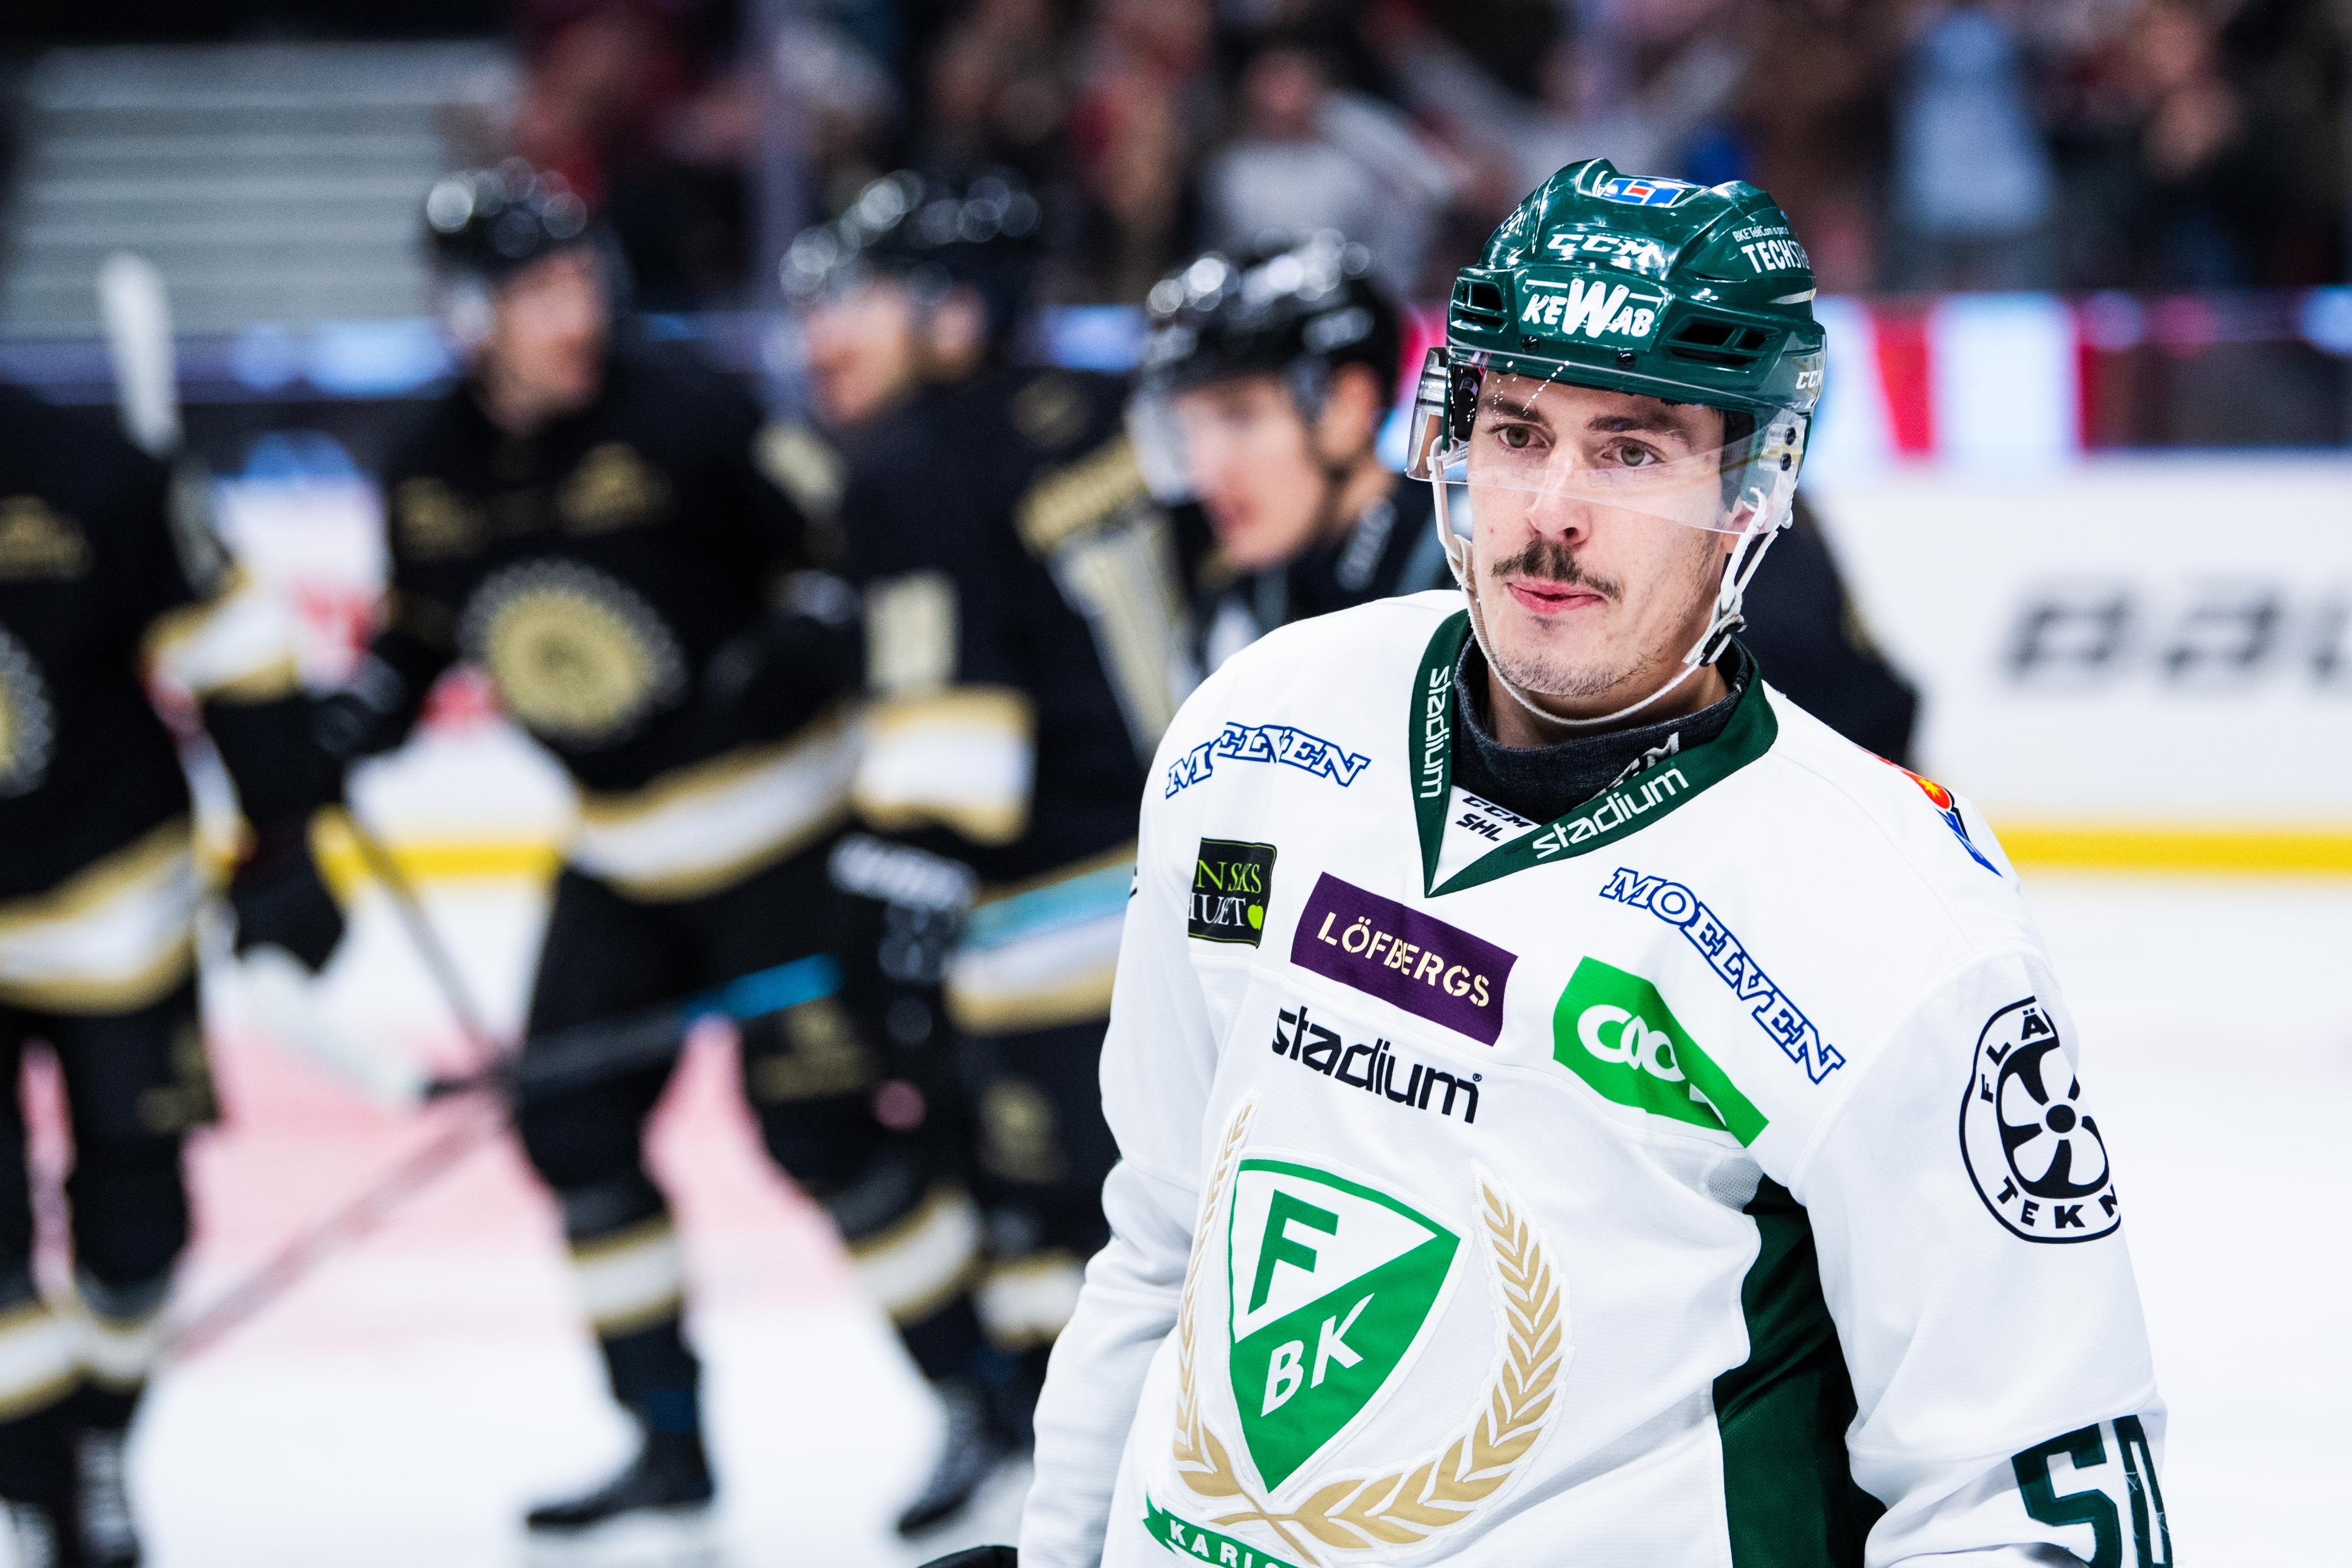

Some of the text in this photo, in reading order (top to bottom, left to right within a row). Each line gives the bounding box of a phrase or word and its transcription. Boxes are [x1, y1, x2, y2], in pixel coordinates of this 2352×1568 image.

[1547, 234, 1659, 262] CCM
[1419, 665, 1452, 799] stadium
[1455, 813, 1503, 842] SHL
[1462, 795, 1533, 828] CCM
[1532, 768, 1689, 859] stadium
[1317, 911, 1489, 1007] LÖFBERGS
[1599, 867, 1846, 1085] MOELVEN
[1247, 1189, 1339, 1316] F
[1260, 1292, 1375, 1417] BK
